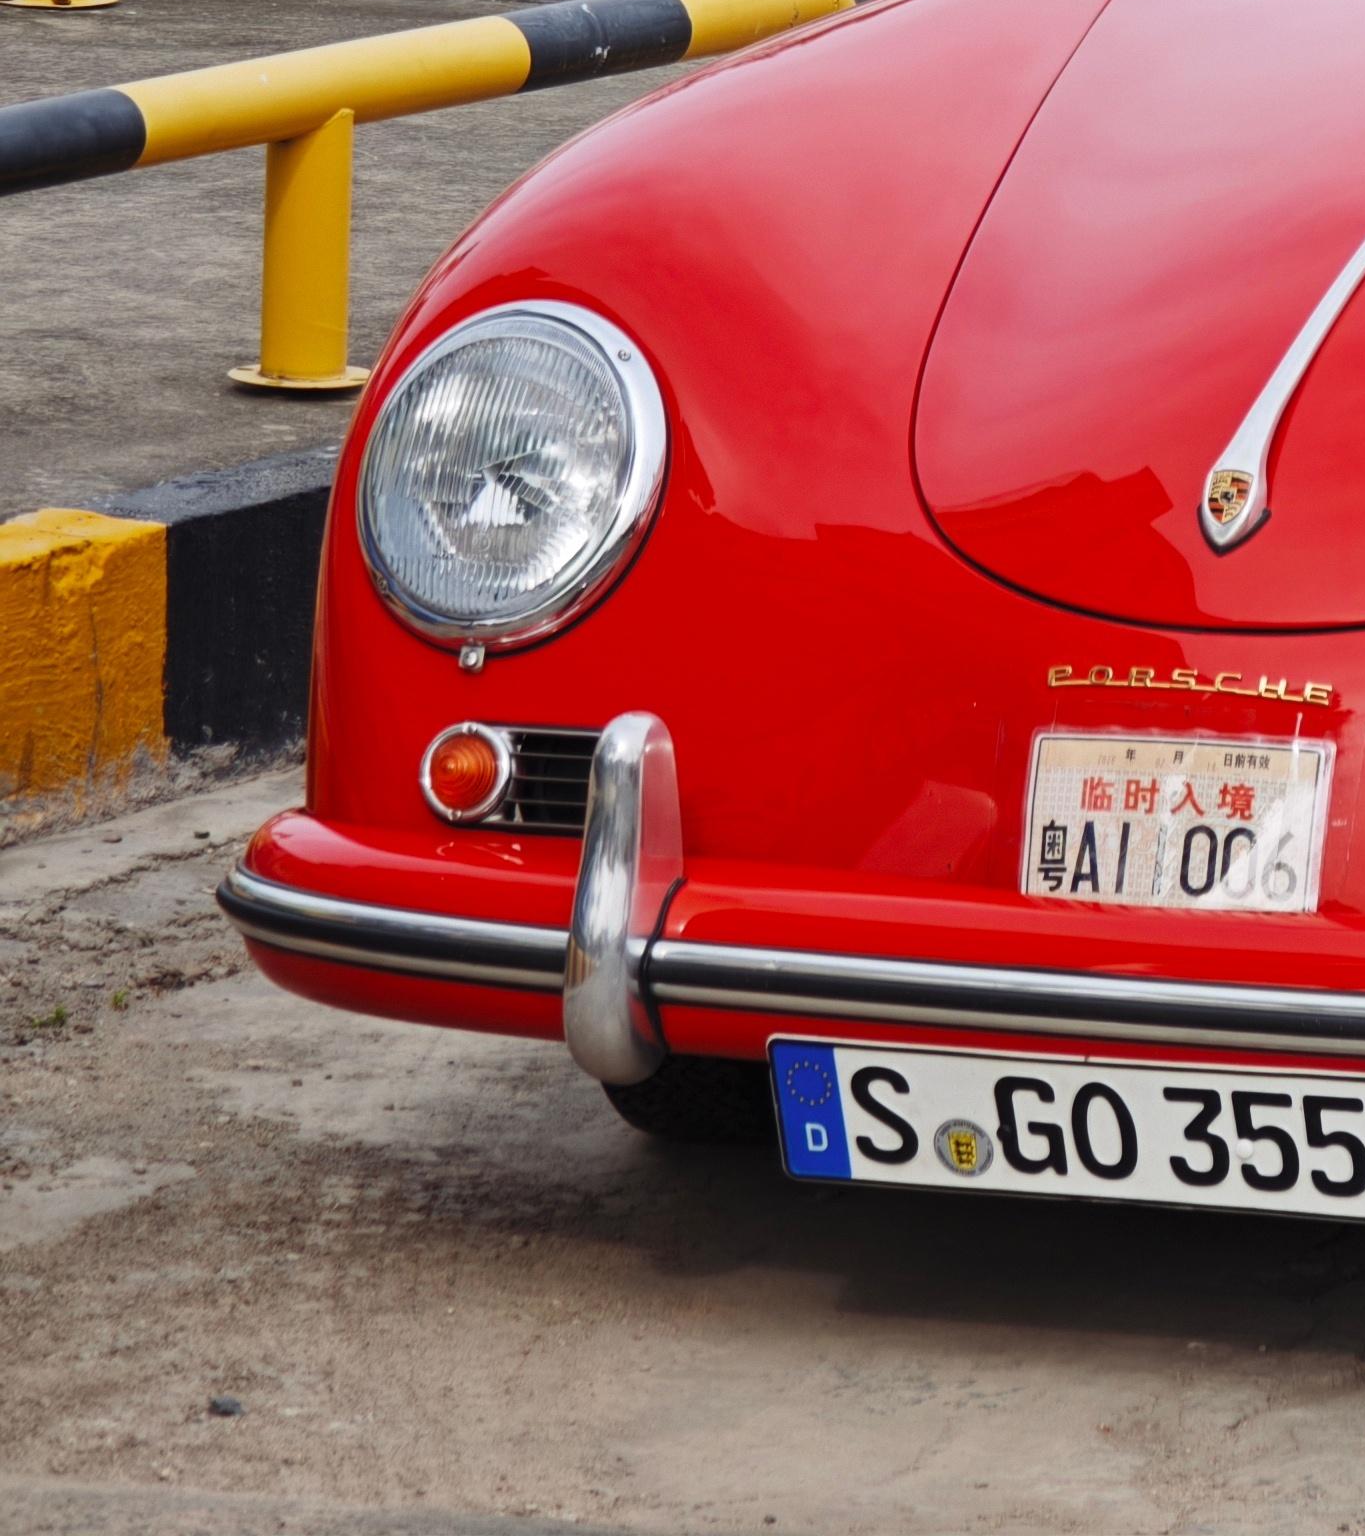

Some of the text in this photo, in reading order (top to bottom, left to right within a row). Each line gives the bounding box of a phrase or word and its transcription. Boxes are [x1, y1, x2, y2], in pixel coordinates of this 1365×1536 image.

[1048, 665, 1333, 706] PORSCHE
[1080, 776, 1256, 822] 临时入境
[805, 1122, 829, 1151] D
[850, 1066, 919, 1164] S
[994, 1076, 1138, 1179] GO
